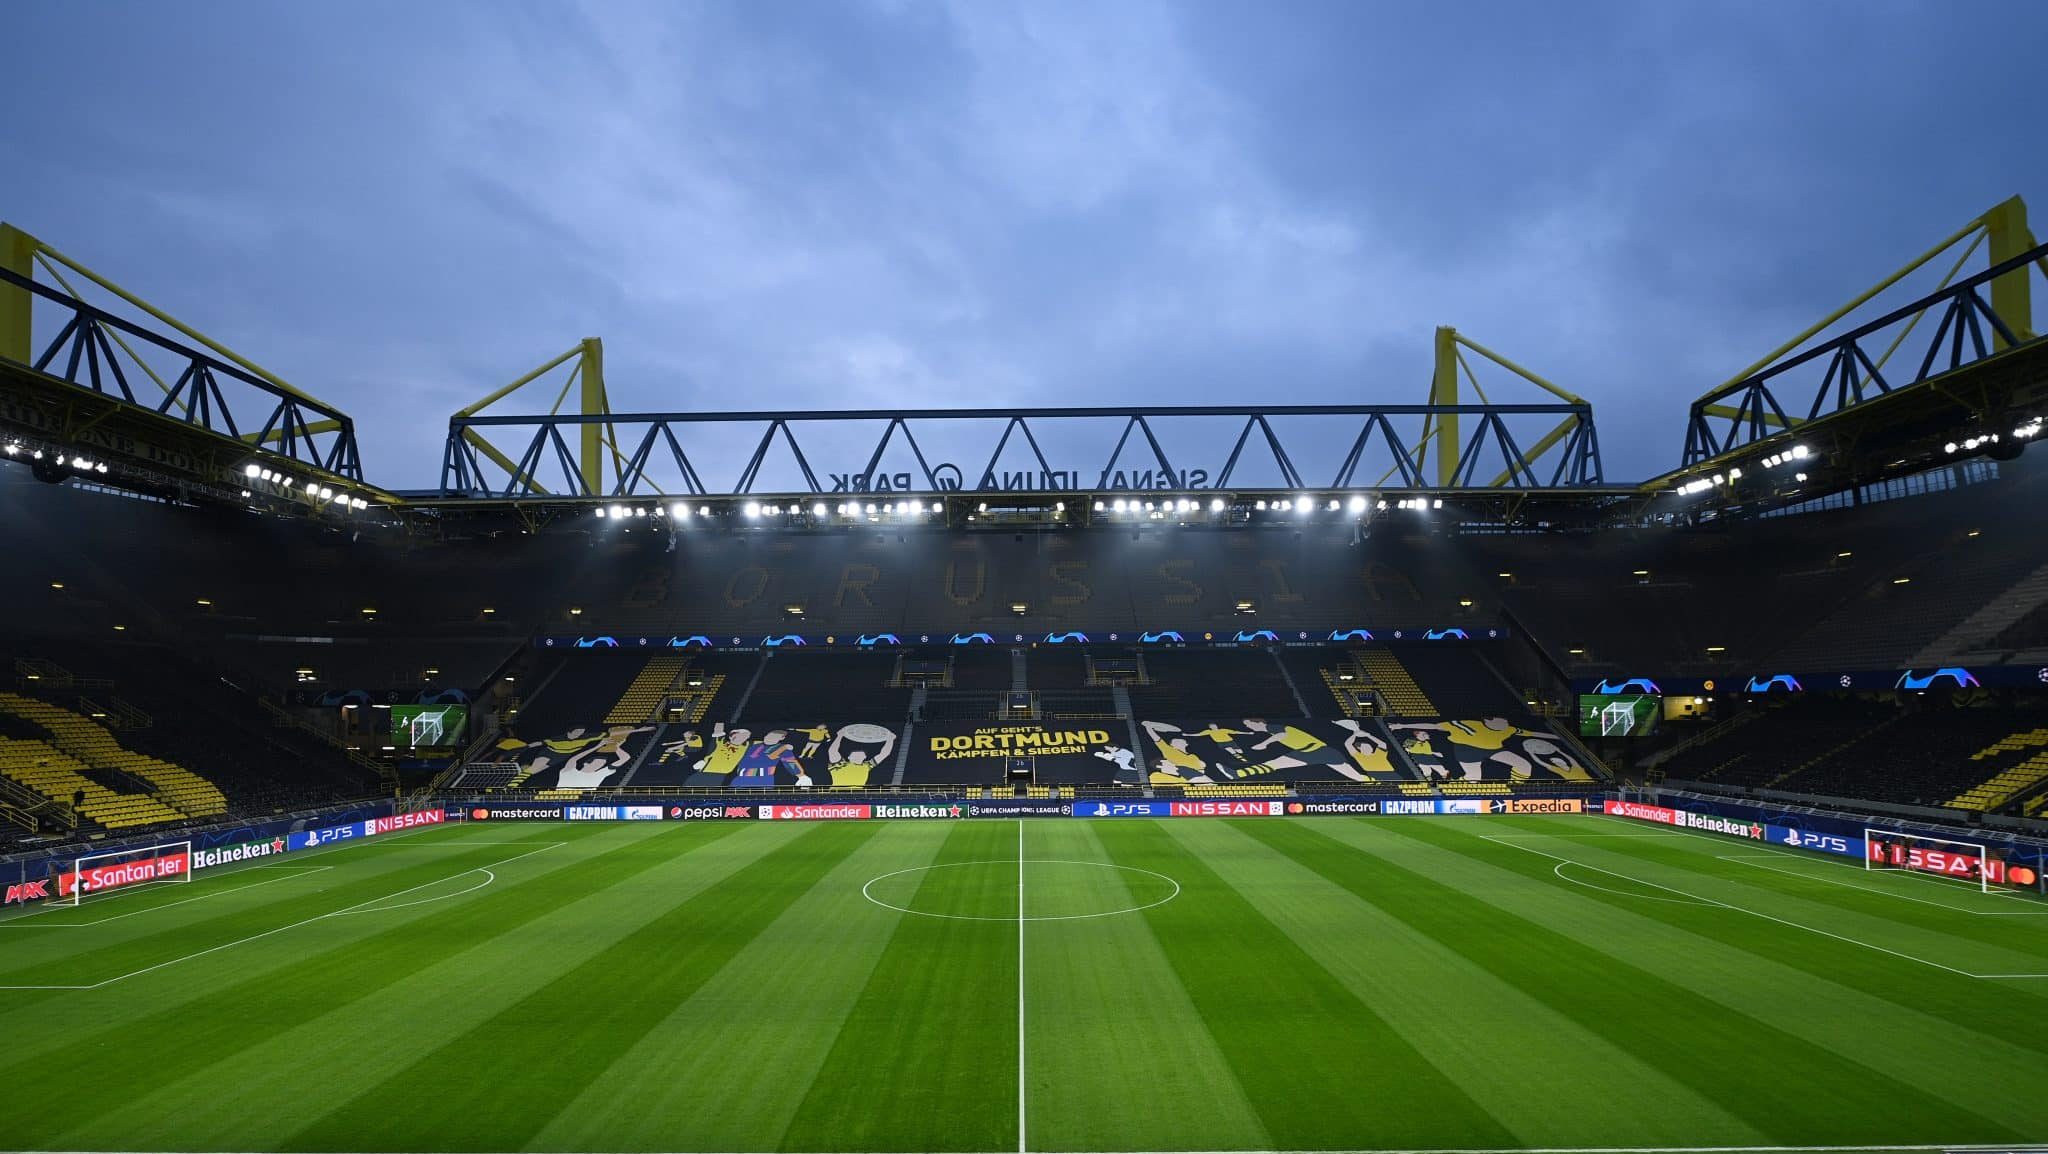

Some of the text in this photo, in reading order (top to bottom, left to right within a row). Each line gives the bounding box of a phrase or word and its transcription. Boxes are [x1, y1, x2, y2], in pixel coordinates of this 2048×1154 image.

[622, 559, 1422, 608] BORUSSIA
[975, 727, 998, 735] AUF
[930, 731, 1110, 751] DORTMUND
[936, 745, 1086, 760] KÄMPFEN & SIEGEN!
[491, 806, 560, 818] mastercard
[569, 806, 617, 819] GAZPROM
[684, 806, 722, 819] pepsi
[795, 806, 861, 818] Santander
[876, 805, 947, 818] Heineken
[1114, 805, 1150, 814] PS5
[1179, 803, 1262, 815] NISSAN
[1306, 802, 1376, 813] mastercard
[1386, 801, 1434, 814] GAZPROM
[1512, 799, 1571, 813] Expedia
[1625, 803, 1671, 822] Santander
[379, 811, 439, 830] NISSAN
[1687, 813, 1748, 836] Heineken
[322, 826, 352, 841] PS5
[1805, 833, 1846, 851] PS5
[193, 842, 270, 869] Heineken
[92, 858, 181, 888] Santander
[5, 879, 49, 903] MAX
